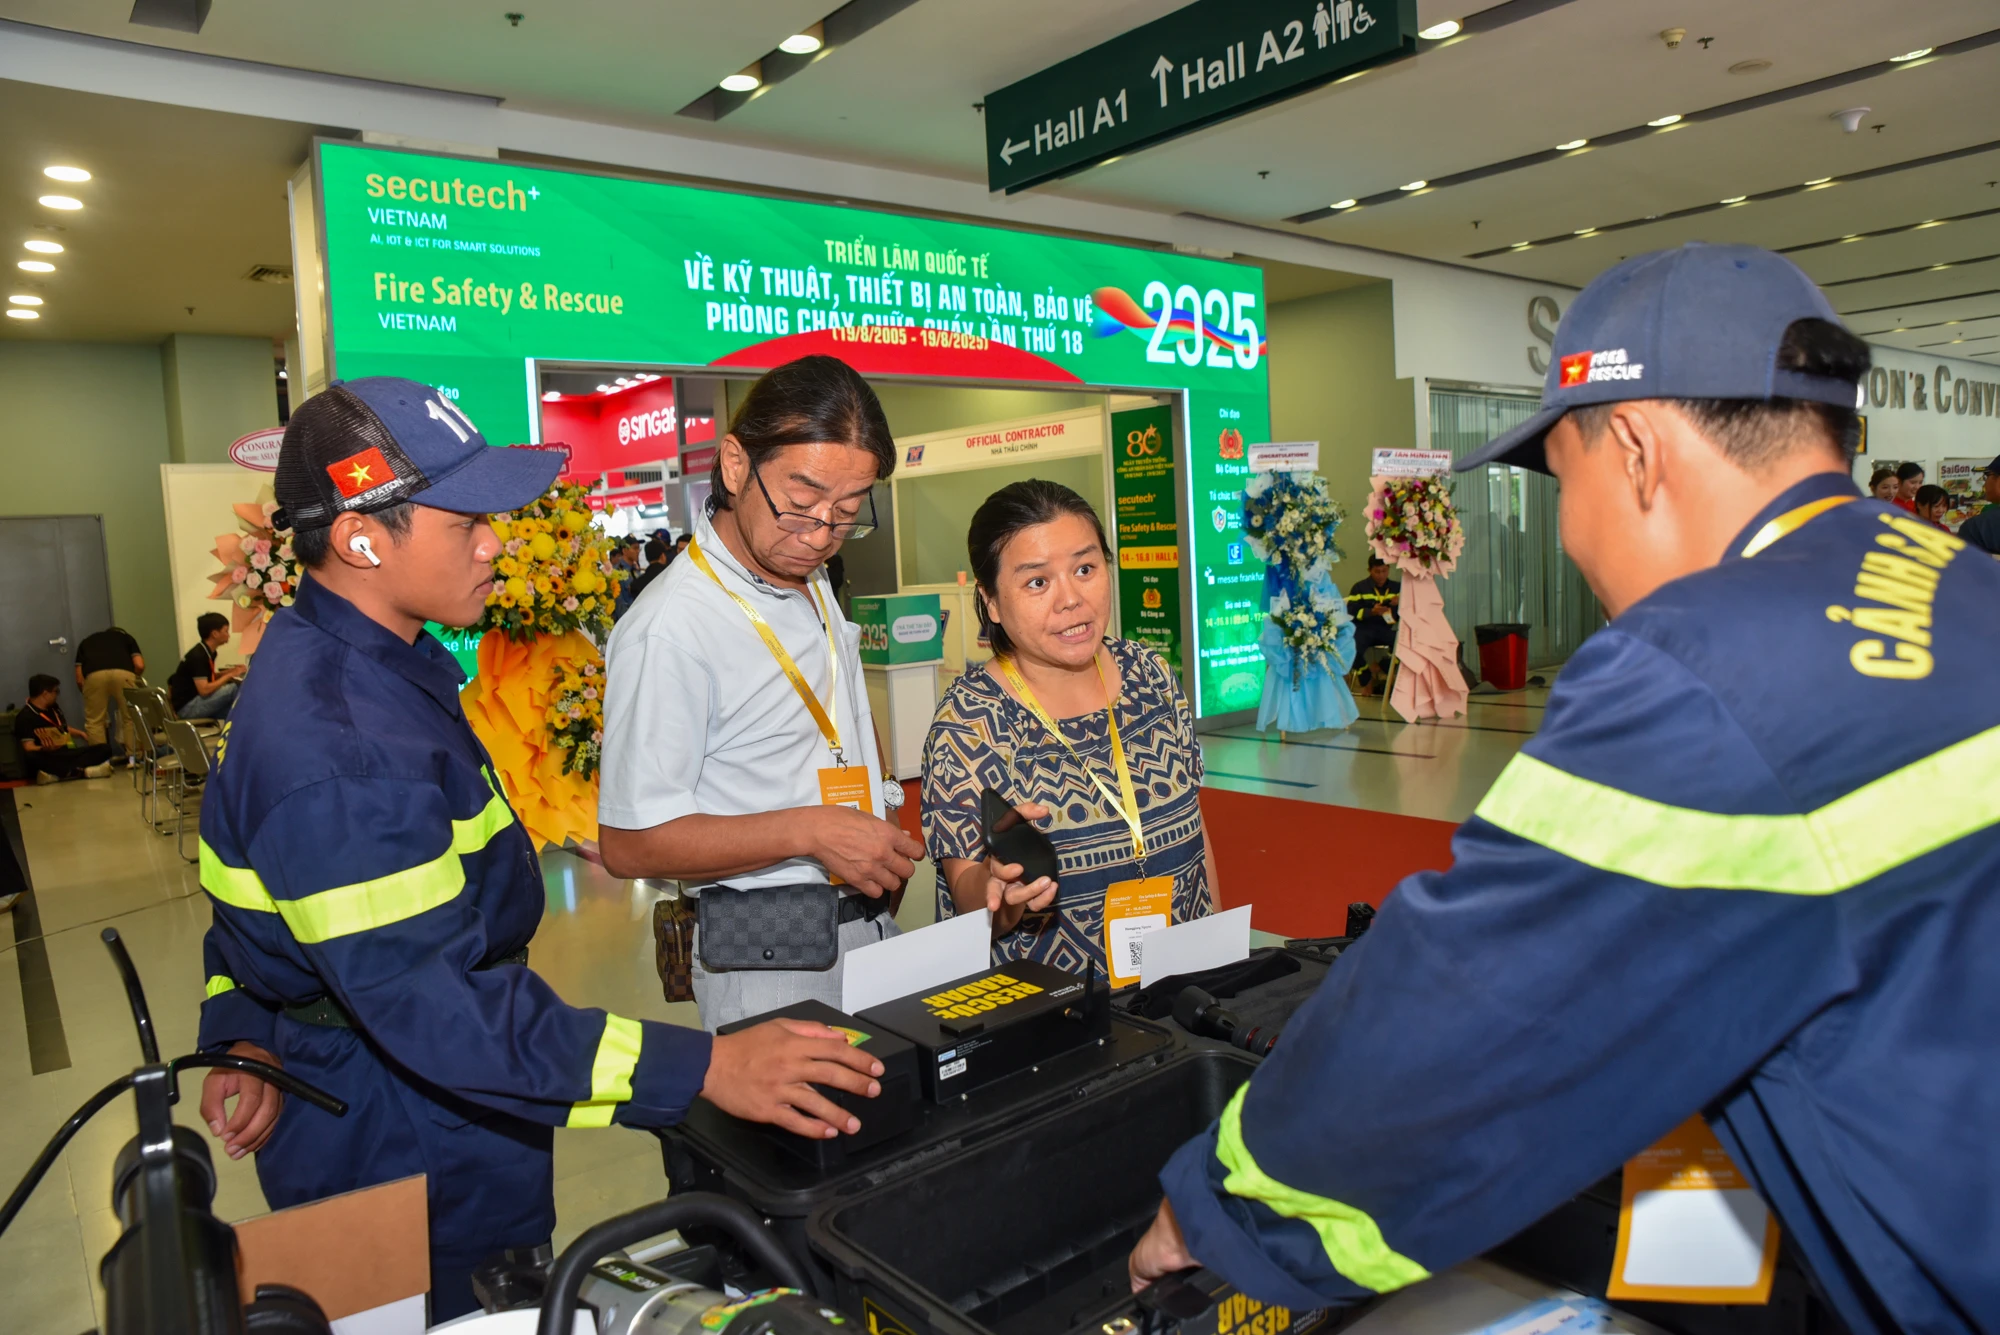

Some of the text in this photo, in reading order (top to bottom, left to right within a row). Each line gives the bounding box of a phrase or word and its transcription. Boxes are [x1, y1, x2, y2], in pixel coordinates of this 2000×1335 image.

[1182, 20, 1304, 99] Hall A2
[1034, 88, 1128, 155] Hall A1
[368, 207, 447, 230] VIETNAM
[386, 235, 401, 246] IOT
[404, 236, 412, 246] &
[415, 237, 430, 248] ICT
[432, 239, 451, 250] FOR
[454, 240, 487, 253] SMART
[489, 243, 541, 257] SOLUTIONS
[824, 235, 990, 279] TRIỂN LÃM QUỐC TẾ
[374, 272, 624, 315] Fire Safety & Rescue
[684, 251, 715, 291] VỀ
[723, 259, 753, 294] KỸ
[845, 271, 903, 306] THIẾT
[911, 281, 931, 313] BỊ
[938, 284, 967, 312] AN
[972, 283, 1028, 322] TOÀN,
[1033, 286, 1069, 321] BẢO
[1073, 294, 1094, 327] VỆ
[378, 312, 456, 332] VIETNAM
[706, 296, 789, 335] PHÒNG
[1022, 322, 1056, 353] THỨ
[1061, 331, 1083, 355] 18
[1143, 281, 1260, 370] 2025
[1587, 363, 1644, 383] RESCUE
[1913, 373, 1928, 411] &
[425, 391, 479, 443] 11
[966, 423, 1065, 448] OFFICIAL CONTRACTOR
[344, 478, 405, 509] FIRE STATION
[1119, 523, 1130, 533] Fire
[1131, 522, 1150, 534] Safety
[1156, 521, 1177, 532] Rescue
[1121, 553, 1129, 562] 14
[1155, 552, 1171, 561] HALL
[1217, 572, 1265, 584] messe frankfur
[921, 973, 1019, 1008] RADAR
[933, 981, 1044, 1020] RESCUE
